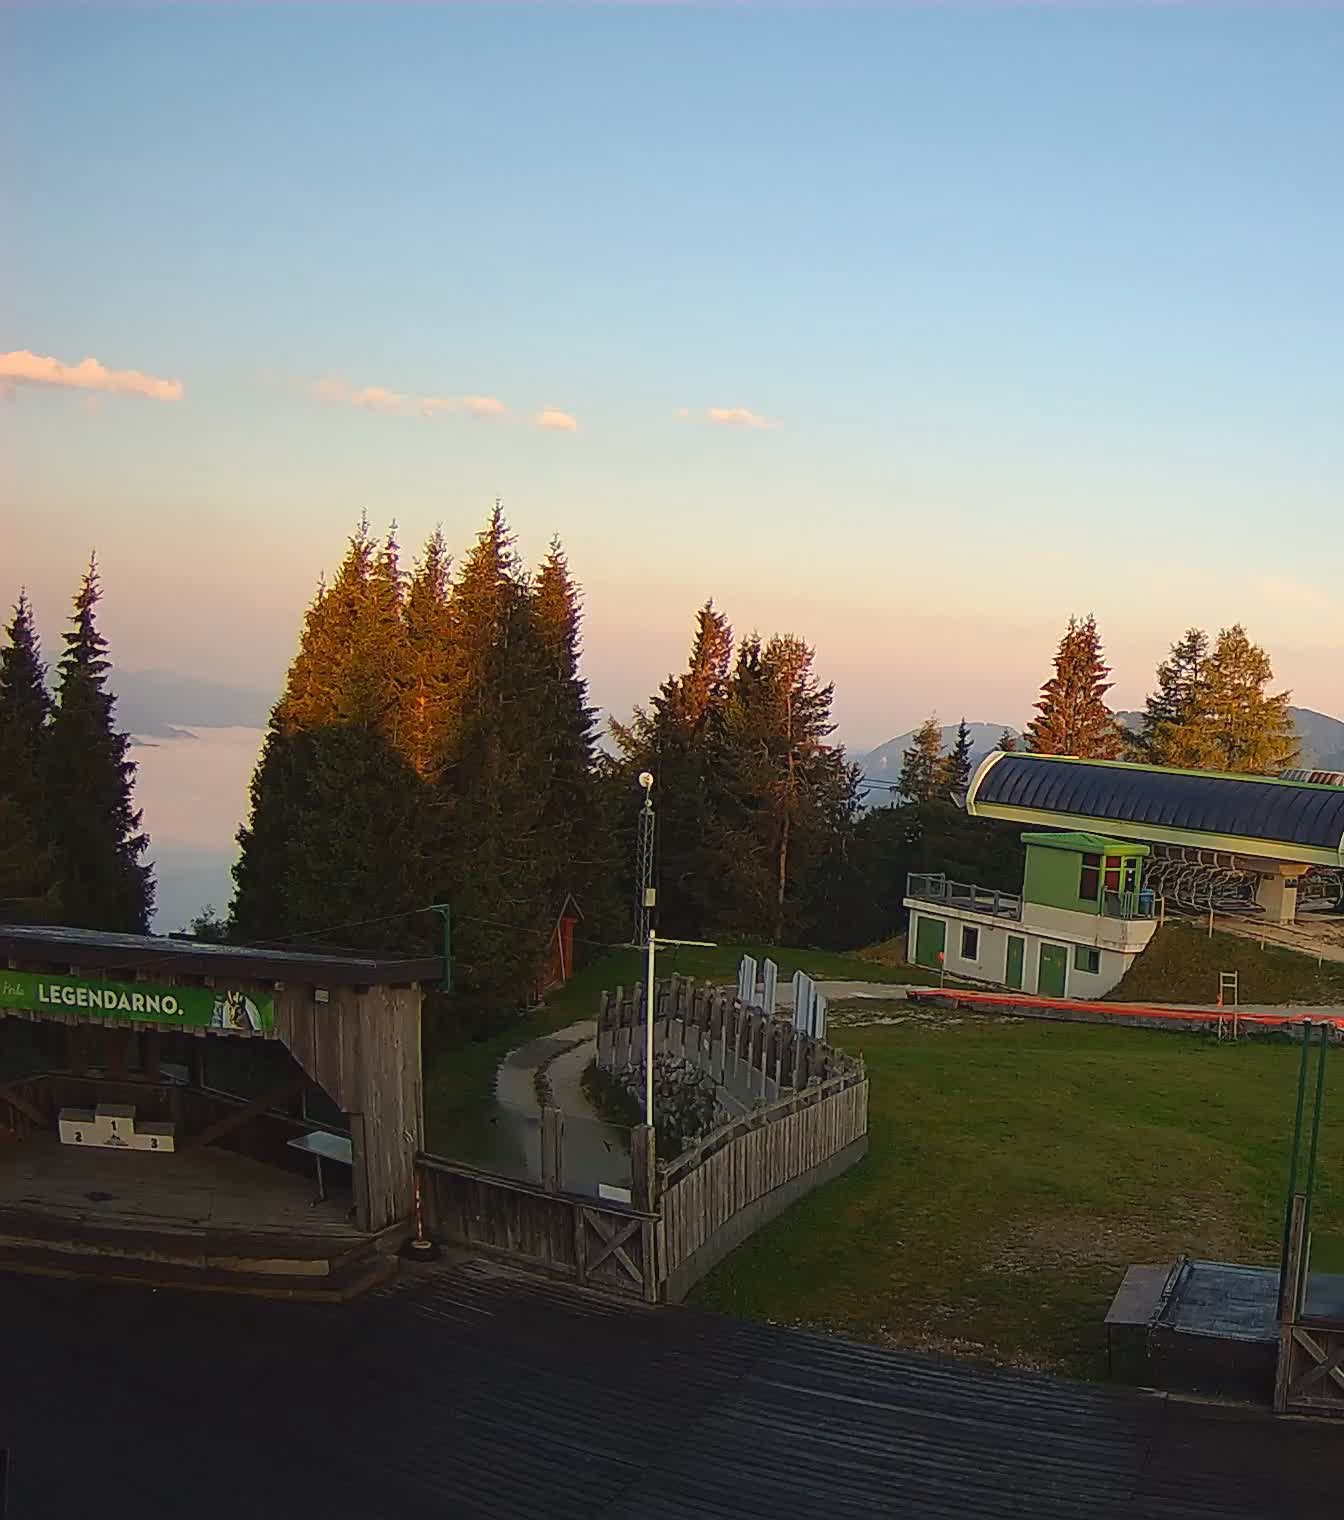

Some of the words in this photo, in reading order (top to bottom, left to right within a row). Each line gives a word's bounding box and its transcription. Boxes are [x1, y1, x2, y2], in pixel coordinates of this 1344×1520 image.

[38, 983, 184, 1016] LEGENDARNO.
[110, 1120, 117, 1131] 1
[74, 1131, 83, 1142] 2
[150, 1138, 158, 1149] 3
